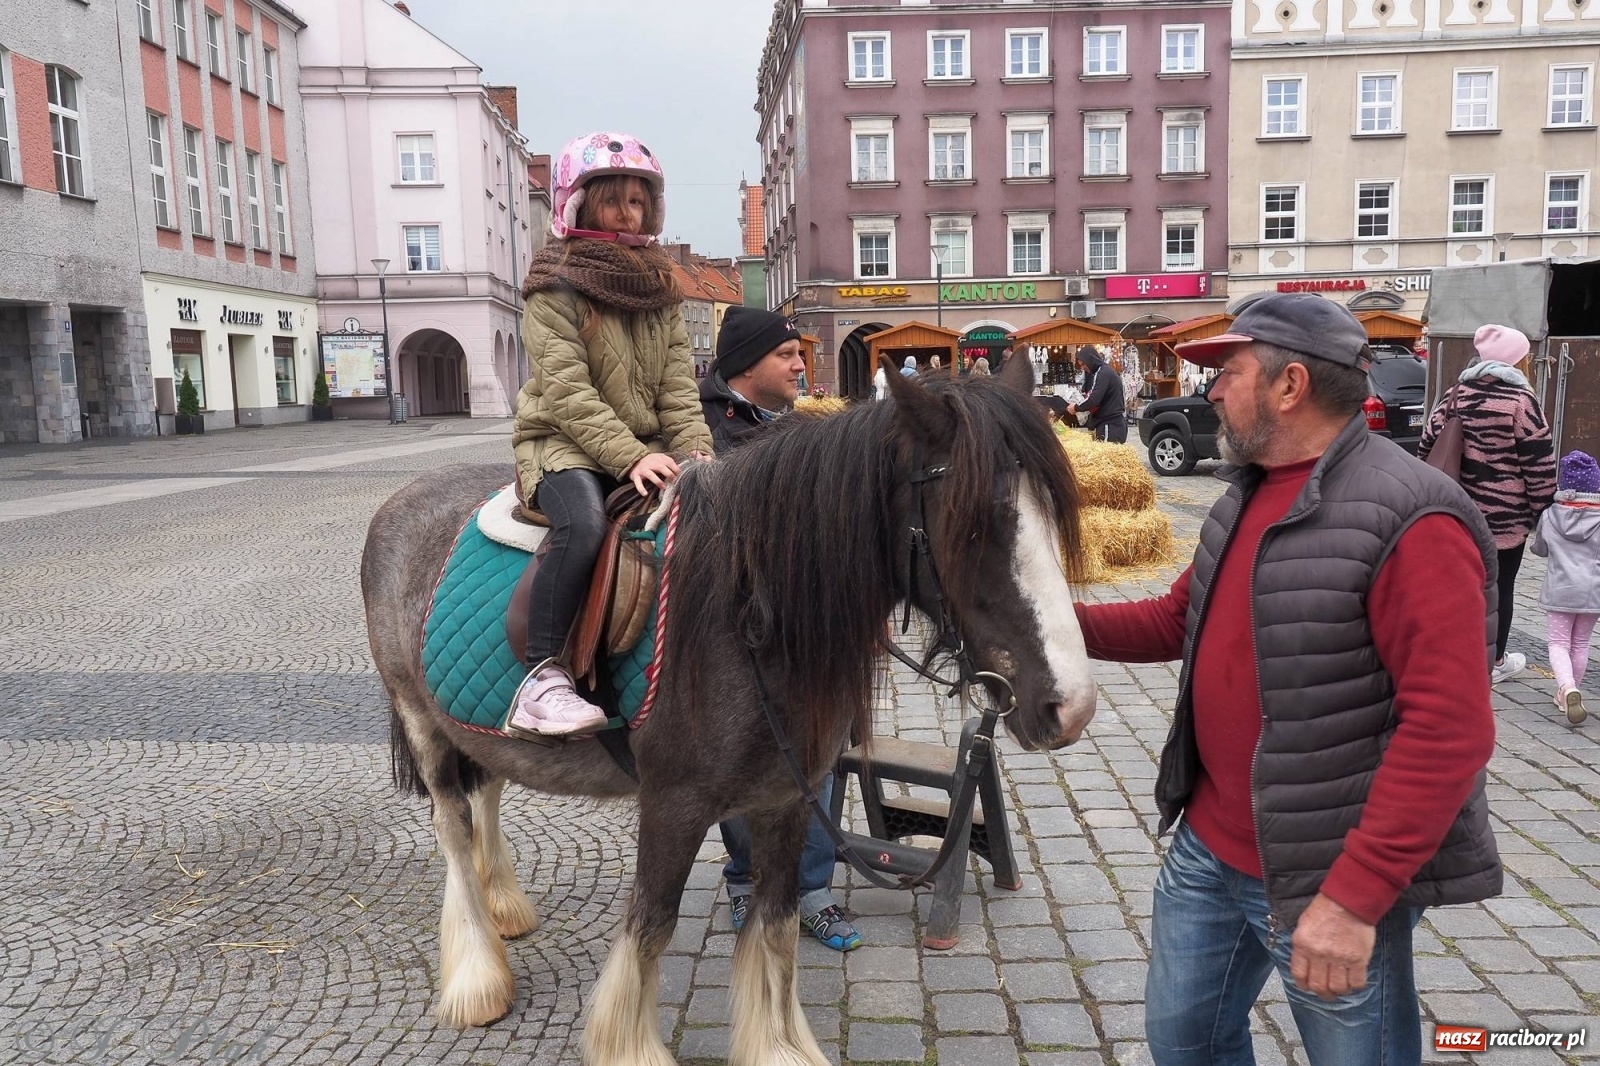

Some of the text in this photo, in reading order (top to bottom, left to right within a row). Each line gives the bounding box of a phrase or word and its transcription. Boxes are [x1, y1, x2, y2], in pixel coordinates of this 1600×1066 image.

[838, 287, 908, 297] TABAC
[940, 282, 1037, 302] KANTOR
[1277, 280, 1366, 293] RESTAURACJA
[969, 332, 1005, 340] KANTOR
